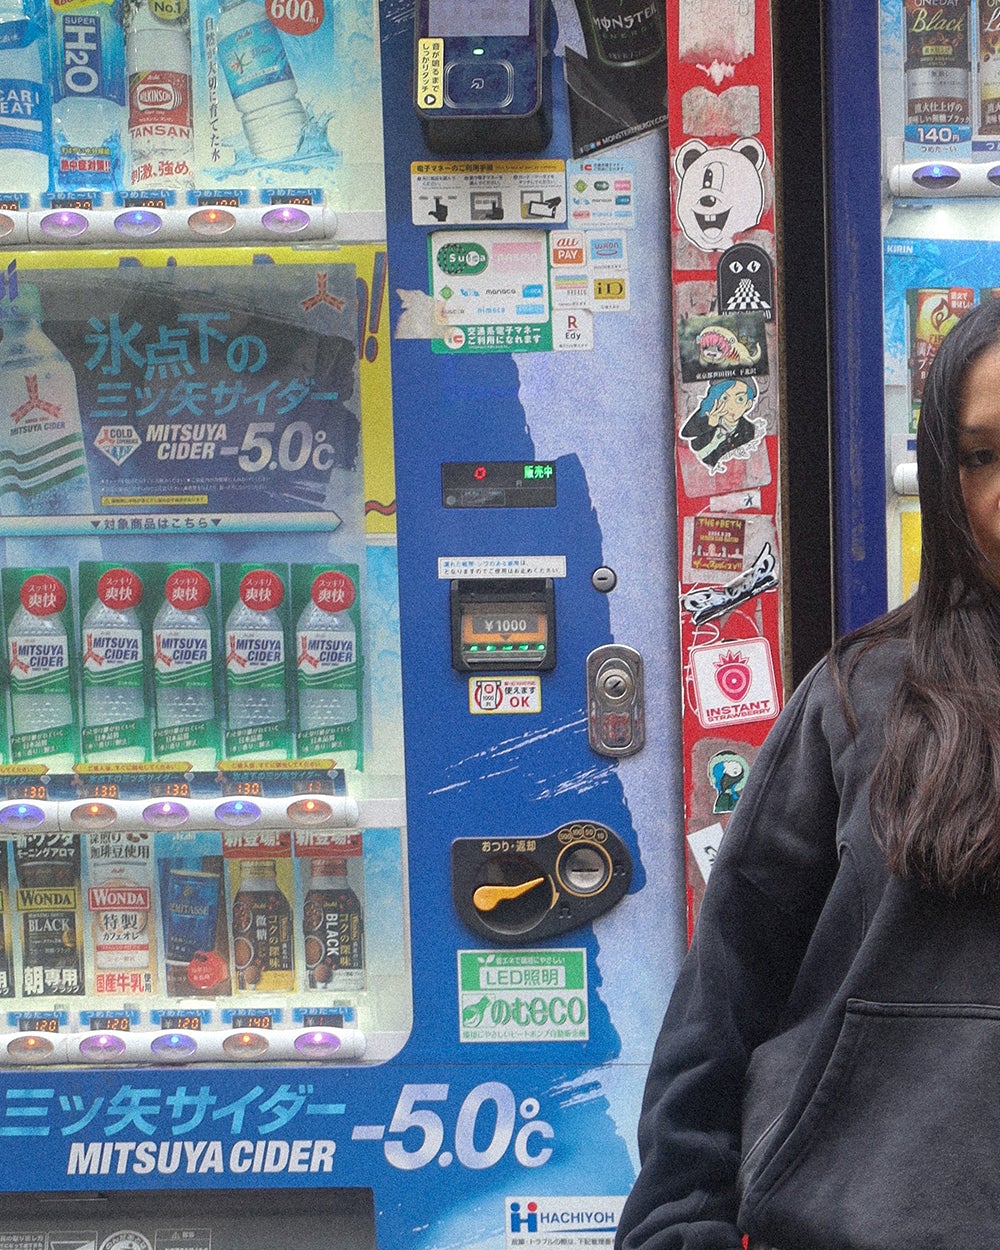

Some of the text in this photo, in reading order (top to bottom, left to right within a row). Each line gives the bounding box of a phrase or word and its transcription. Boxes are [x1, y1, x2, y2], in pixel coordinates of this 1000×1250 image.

[153, 1, 183, 14] No.1
[64, 16, 96, 25] SUPER
[909, 7, 965, 33] Black
[130, 125, 191, 139] TANSAN
[556, 237, 579, 248] au
[886, 244, 914, 254] KIRIN
[557, 250, 579, 261] PAY
[597, 281, 623, 294] iD
[565, 332, 581, 342] Edy
[84, 311, 268, 380] 氷点下の
[90, 379, 338, 418] 三ツ矢サイダー
[10, 423, 42, 437] MITSUYA
[110, 428, 133, 438] COLD
[146, 423, 227, 443] MITSUYA
[157, 442, 216, 460] CIDER
[523, 465, 553, 480] 販売中
[103, 518, 209, 530] 対象商品はこちら
[105, 587, 133, 601] 爽快
[172, 587, 199, 601] 爽快
[244, 588, 272, 602] 爽快
[318, 589, 345, 603] 爽快
[28, 594, 57, 608] 爽快
[484, 619, 527, 632] ¥1000
[93, 637, 139, 649] MITSUYA
[162, 637, 208, 649] MITSUYA
[236, 638, 281, 650] MITSUYA
[307, 638, 353, 650] MITSUYA
[18, 644, 64, 656] MITSUYA
[104, 649, 138, 661] CIDER
[172, 649, 207, 661] CIDER
[247, 650, 281, 662] CIDER
[29, 656, 64, 668] CIDER
[319, 651, 353, 663] CIDER
[504, 686, 537, 695] 使えます
[509, 696, 531, 708] OK
[706, 700, 770, 717] INSTANT
[707, 707, 771, 722] STRAWBERRY
[23, 786, 46, 799] 130
[93, 785, 118, 797] 130
[166, 783, 189, 796] 130
[237, 782, 260, 795] 130
[17, 848, 75, 858] モーニングアロマ
[90, 845, 150, 859] 珈琲豆使用
[20, 890, 72, 906] WONDA
[93, 889, 145, 906] WONDA
[28, 918, 70, 933] BLACK
[103, 913, 139, 931] 特製
[102, 931, 140, 941] カフェオレ
[325, 912, 340, 957] BLACK
[24, 965, 78, 995] 朝専用
[96, 973, 145, 993] 国産牛乳
[486, 968, 559, 986] LED照明
[34, 1019, 58, 1032] 120
[106, 1018, 129, 1030] 120
[177, 1017, 199, 1029] 120
[0, 1084, 346, 1137] 三ツ矢サイダー
[67, 1139, 336, 1175] MITSUYA CIDER
[540, 1211, 615, 1224] HACHIYOH
